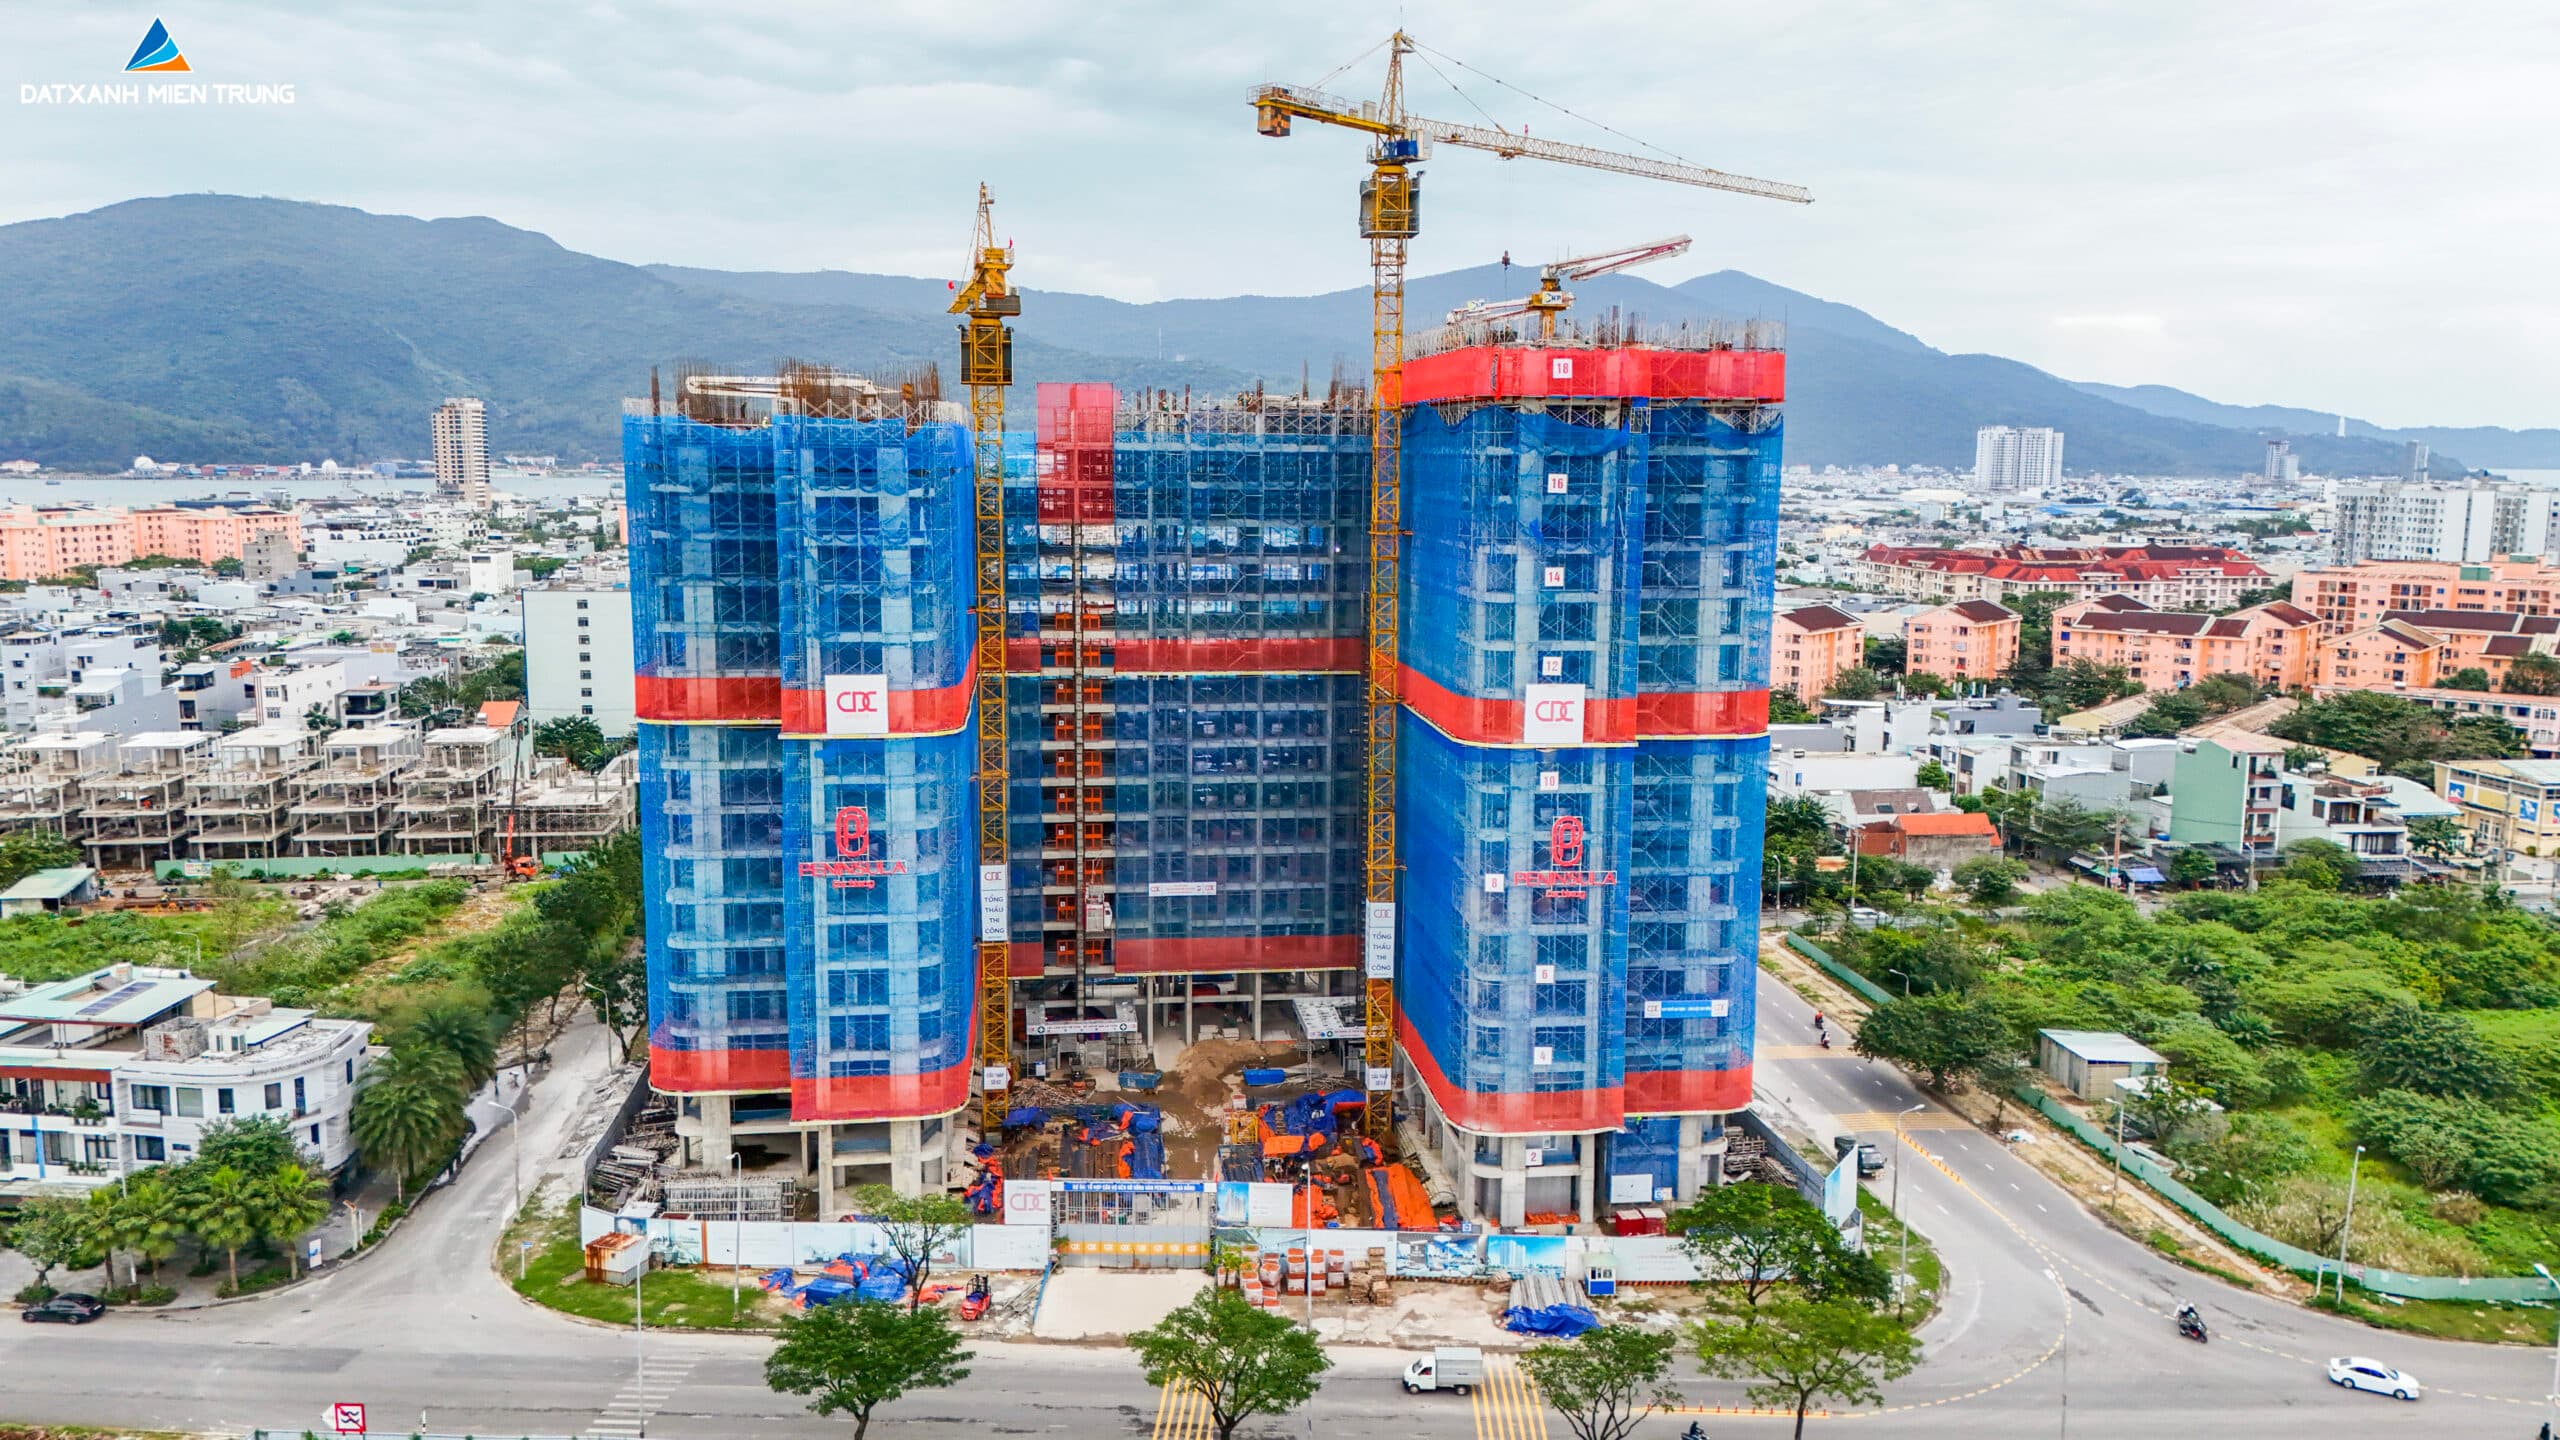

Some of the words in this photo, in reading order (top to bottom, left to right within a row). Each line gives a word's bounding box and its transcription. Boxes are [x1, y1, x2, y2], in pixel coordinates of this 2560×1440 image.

[1557, 362, 1569, 374] 18
[1551, 478, 1564, 489] 16
[1548, 571, 1561, 582] 14
[1545, 660, 1559, 672] 12
[1543, 775, 1556, 787] 10
[1530, 1151, 1537, 1162] 2
